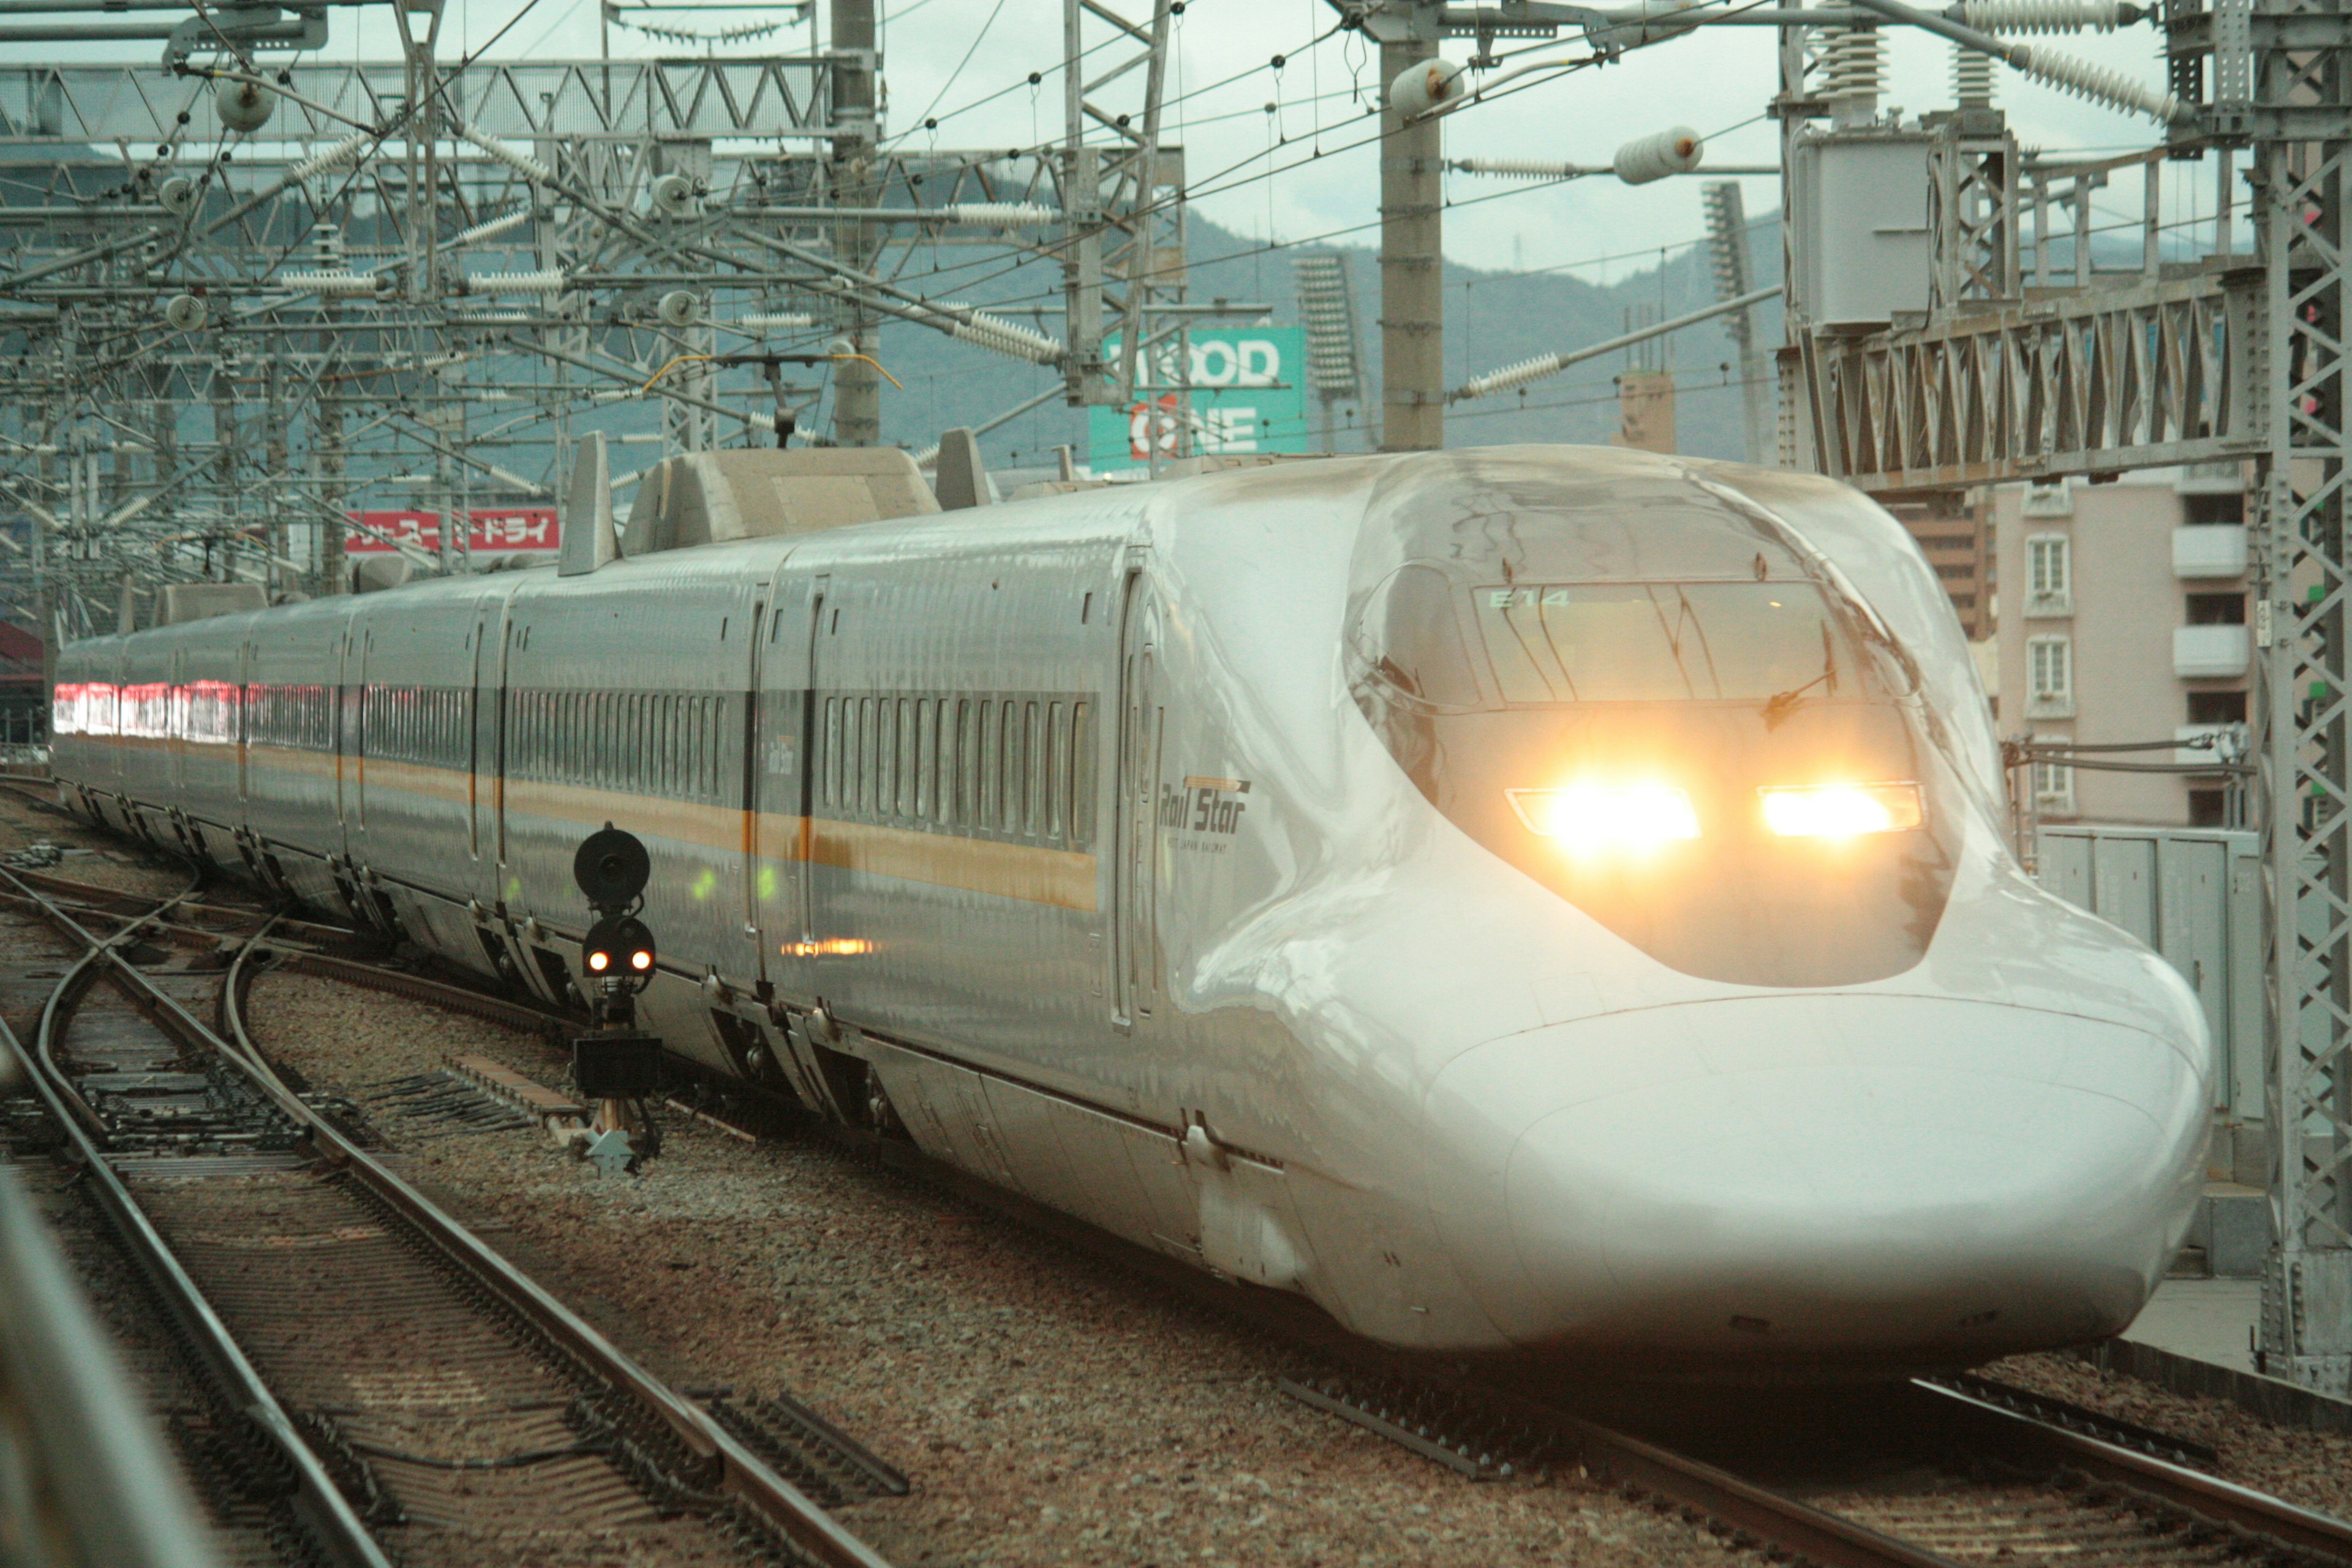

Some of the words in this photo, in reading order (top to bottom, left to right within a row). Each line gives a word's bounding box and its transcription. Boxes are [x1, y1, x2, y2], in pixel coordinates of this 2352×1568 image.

[1132, 407, 1257, 453] ONE
[1489, 590, 1569, 607] E14
[1160, 783, 1191, 829] Rail
[1195, 788, 1245, 834] Star
